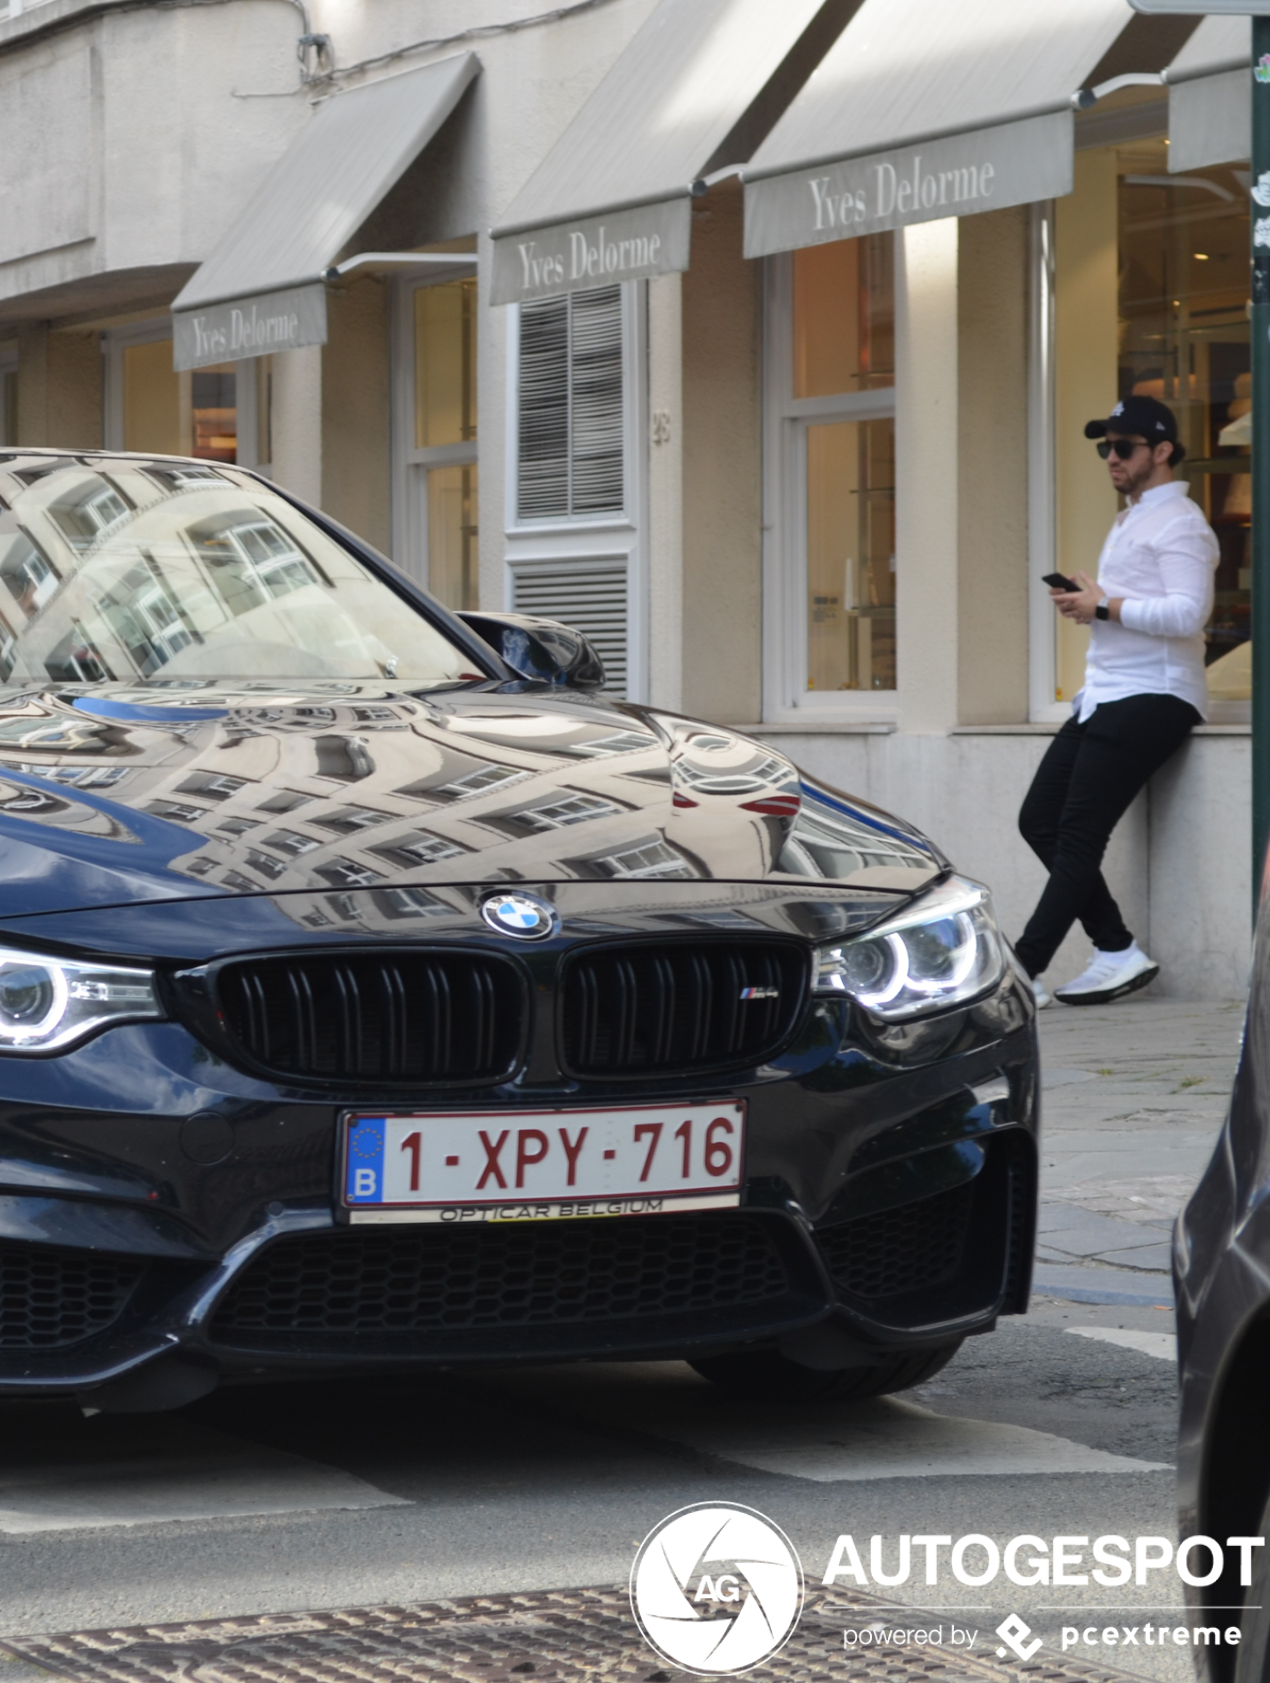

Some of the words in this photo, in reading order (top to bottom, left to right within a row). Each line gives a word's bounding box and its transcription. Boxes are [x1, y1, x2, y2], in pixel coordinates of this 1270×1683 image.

[808, 177, 866, 230] Yves
[874, 156, 995, 218] Delorme
[518, 241, 564, 289] Yves
[569, 226, 661, 280] Delorme
[192, 316, 226, 357] Yves
[231, 305, 298, 350] Delorme
[486, 896, 539, 910] BMW
[354, 1168, 377, 1197] B
[439, 1206, 550, 1222] OPTICAR
[559, 1199, 663, 1218] BELGIUM
